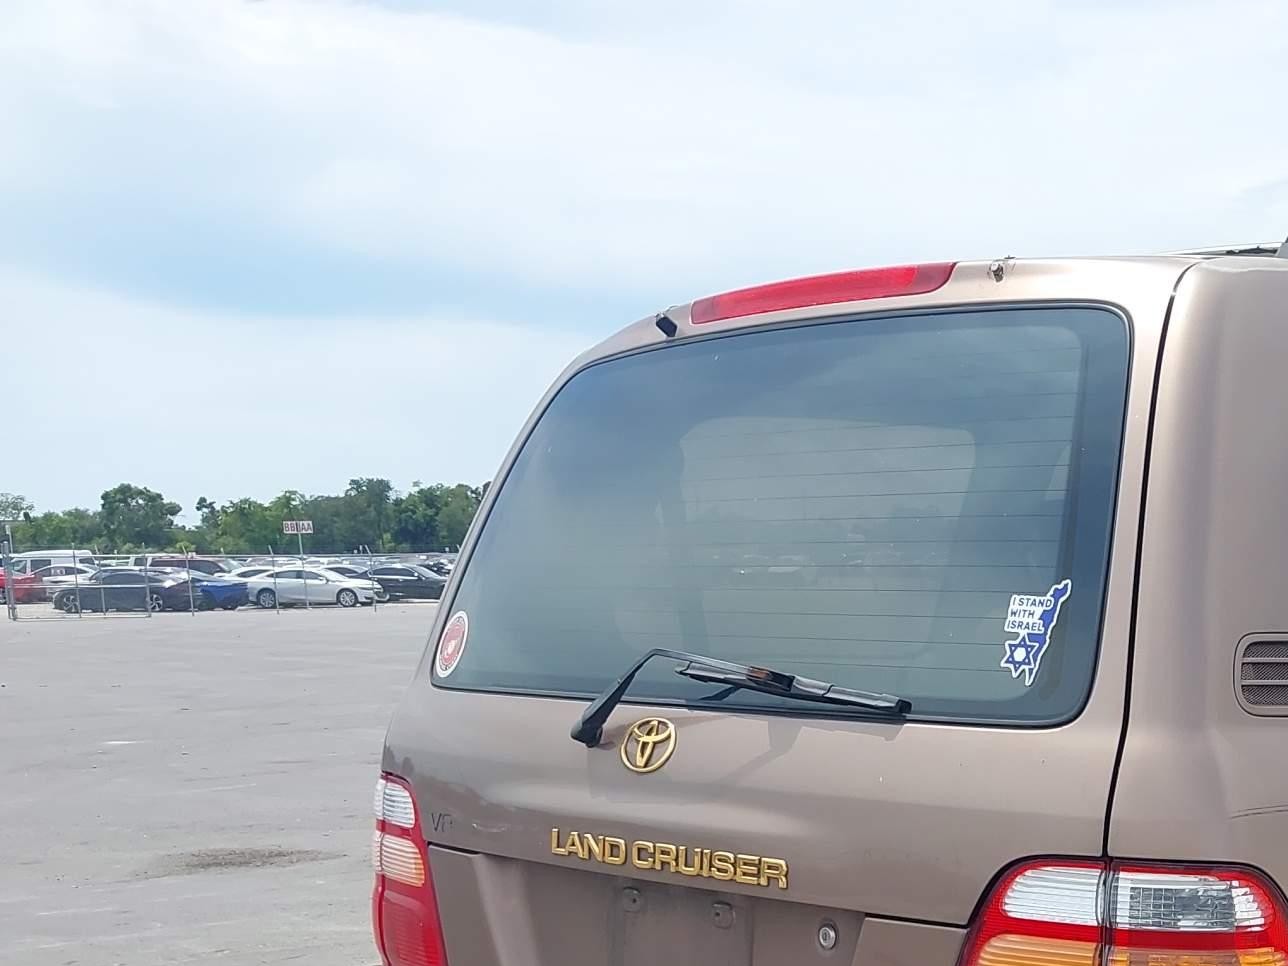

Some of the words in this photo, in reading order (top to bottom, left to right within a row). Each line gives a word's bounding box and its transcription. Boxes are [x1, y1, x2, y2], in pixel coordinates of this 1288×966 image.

[1018, 597, 1053, 608] STAND
[1010, 608, 1036, 619] WITH
[1006, 620, 1044, 632] ISRAEL
[551, 827, 627, 866] LAND
[631, 840, 789, 890] CRUISER
